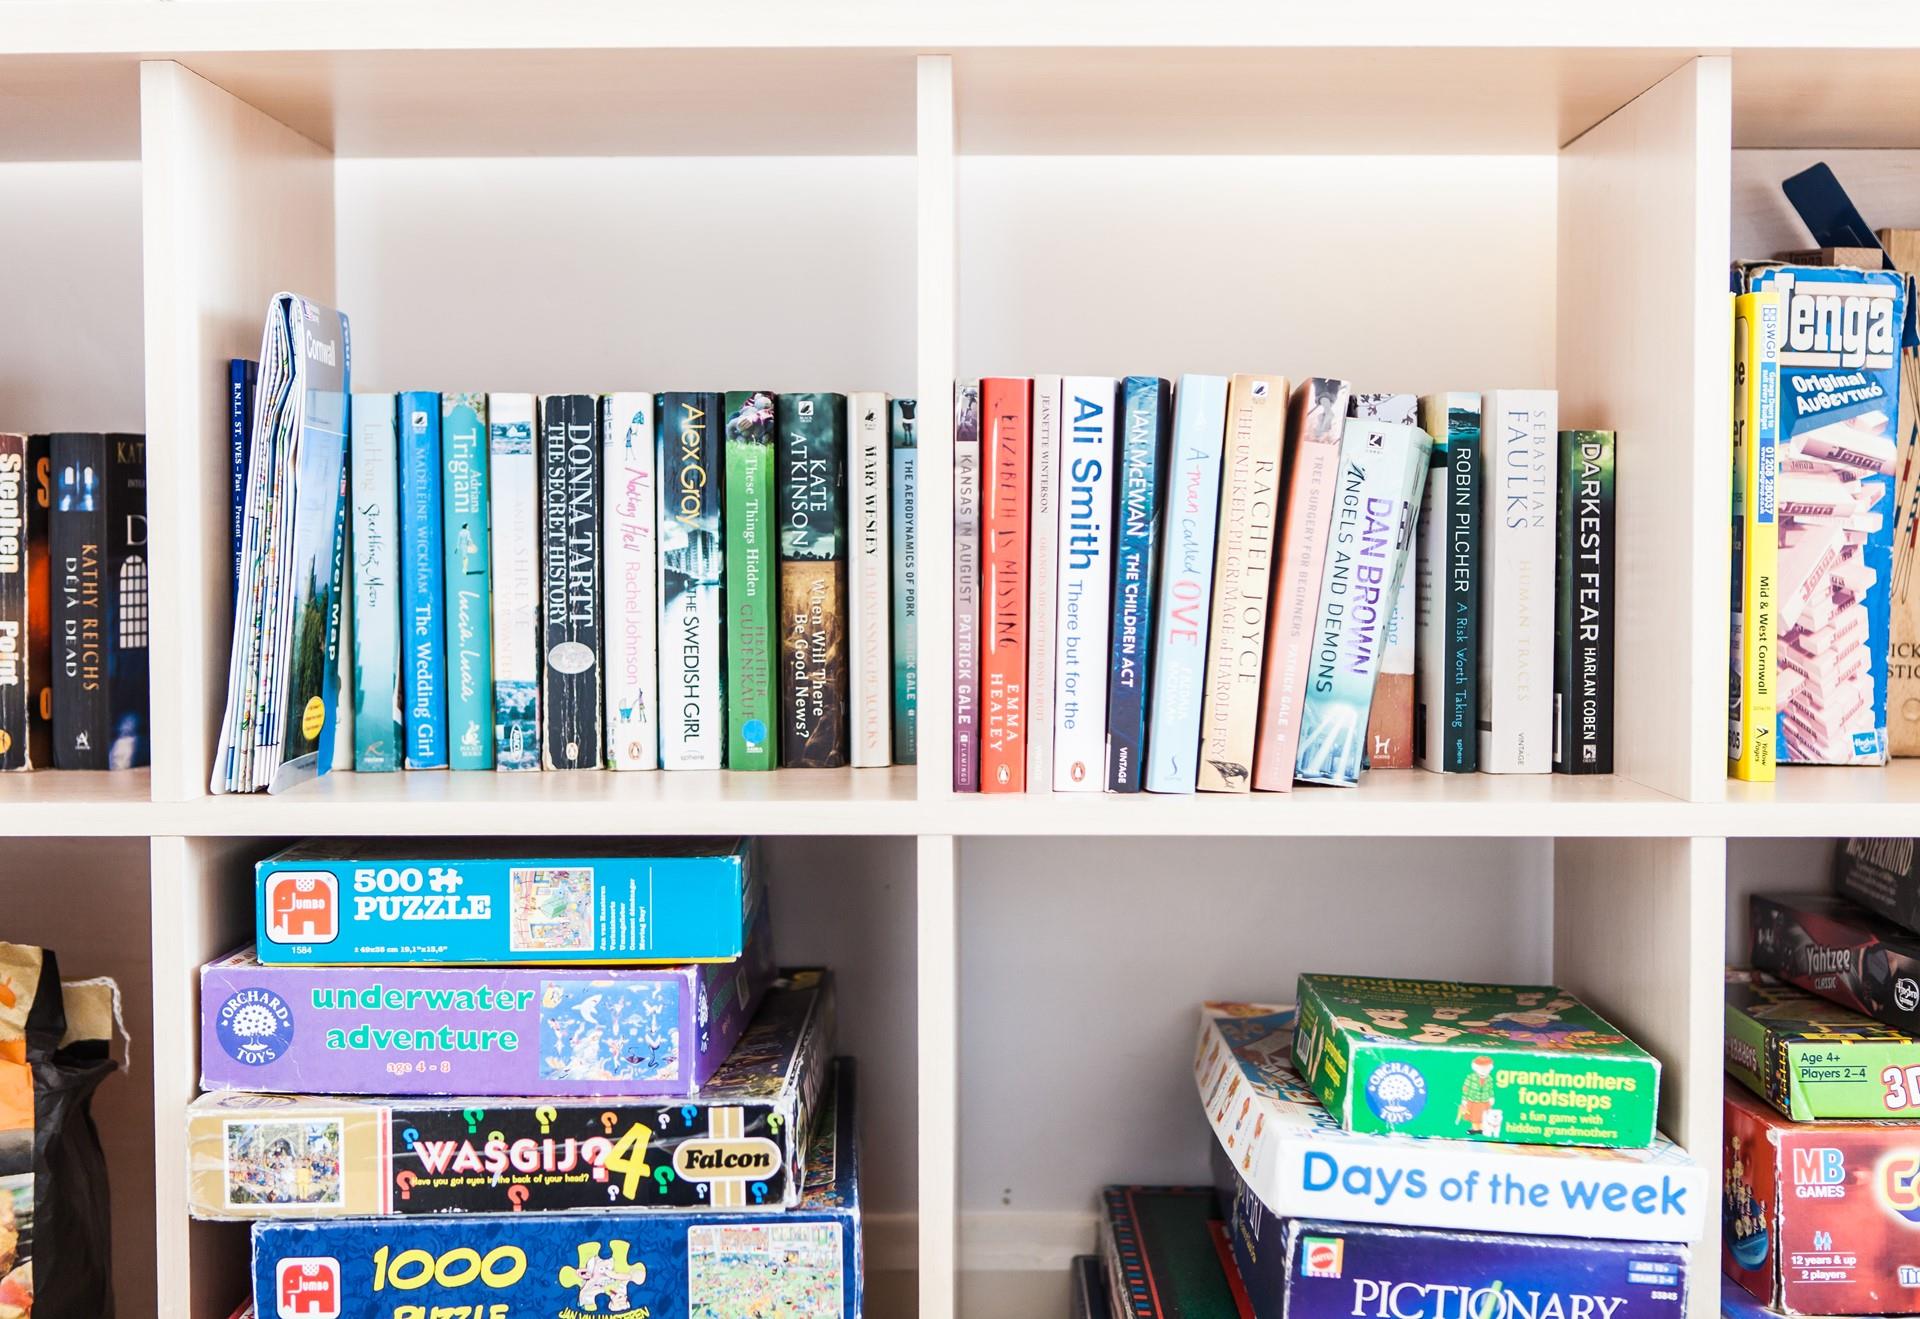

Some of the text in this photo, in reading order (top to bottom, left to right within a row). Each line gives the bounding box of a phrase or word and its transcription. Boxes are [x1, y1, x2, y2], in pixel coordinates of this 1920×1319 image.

[306, 330, 336, 367] Cornwall
[1766, 323, 1776, 359] SWGD
[1775, 272, 1894, 369] Jenga
[1792, 372, 1867, 394] Original
[1796, 382, 1884, 415] Αυθεντικό
[448, 428, 476, 514] Trigiani
[675, 402, 707, 529] Alex Gray
[810, 459, 827, 512] KATE
[864, 445, 878, 491] MARY
[1039, 394, 1050, 514] JEANETTE WINTERSON
[1069, 396, 1103, 570] Ali Smith
[1126, 410, 1148, 536] IAN McEWAN
[1186, 447, 1210, 462] A
[1506, 411, 1529, 529] FAULKS
[1532, 410, 1546, 528] SEBASTIAN
[1766, 446, 1775, 515] 01208 280037
[469, 468, 482, 513] Adriana
[616, 466, 650, 553] Notting Hell
[791, 432, 809, 547] ATKINSON
[1186, 464, 1201, 513] man
[1246, 460, 1274, 577] RACHEL
[1454, 448, 1471, 592] ROBIN PILCHER
[548, 422, 567, 627] THE SECRET HISTORY
[567, 422, 593, 627] DONNA TARTT
[743, 456, 760, 597] These Things Hidden
[865, 494, 878, 559] WESLEY
[904, 459, 916, 617] THE AERODYNAMICS OF PORK
[960, 454, 973, 604] KANSAS IN AUGUST
[998, 415, 1018, 649] ELIZABETH IS MISSING
[1182, 518, 1201, 575] called
[1291, 455, 1325, 638] TREE SURGERY FOR BEGINNERS
[1360, 497, 1393, 560] DAN
[1579, 443, 1601, 641] DARKEST FEAR
[329, 506, 346, 661] Travel Map
[412, 447, 435, 757] MADELEINE WICKHAM The Wedding Girl
[1316, 462, 1366, 693] ANGELS AND DEMONS
[1759, 576, 1770, 598] Mid
[1759, 600, 1769, 610] &
[81, 543, 99, 691] KATHY REICHS
[625, 562, 643, 685] Rachel Johnson
[1119, 553, 1140, 688] THE CHILDREN ACT
[1169, 580, 1202, 647] OVE
[1237, 590, 1263, 685] JOYCE
[1345, 564, 1384, 676] BROWN
[1758, 613, 1768, 642] West
[740, 603, 755, 719] GUDENKAUF
[755, 625, 768, 698] HEATHER
[795, 613, 811, 739] Be Good News?
[811, 580, 827, 718] When Will There
[957, 613, 973, 725] PATRICK GALE
[1064, 579, 1083, 730] There but for the
[1452, 602, 1468, 728] A Risk Worth Taking
[1583, 647, 1596, 696] HARLAN
[1757, 645, 1768, 695] Cornwall
[990, 673, 1003, 752] HEALEY
[1007, 684, 1020, 742] EMMA
[1278, 643, 1298, 727] PATRICK GALE
[1517, 733, 1525, 766] VINTAGE
[1583, 700, 1597, 740] COBEN
[960, 743, 968, 783] FLAMINGO
[1117, 746, 1128, 784] VINTAGE
[353, 867, 424, 893] 500
[353, 895, 492, 921] PUZZLE
[291, 946, 313, 955] 1584
[1806, 946, 1851, 976] Yahtzee
[221, 991, 289, 1020] ORCHARD
[311, 983, 535, 1012] underwater
[236, 1046, 276, 1064] TOYS
[325, 1024, 519, 1052] adventure
[1800, 1052, 1841, 1064] Age 4+
[1495, 1067, 1637, 1092] grandmothers
[1518, 1087, 1612, 1112] footsteps
[1505, 1122, 1618, 1140] hidden grandmothers
[1520, 1112, 1604, 1127] a fun game with
[411, 1176, 431, 1186] Have
[433, 1177, 449, 1188] you
[450, 1177, 465, 1187] got
[466, 1178, 485, 1187] eyes
[498, 1175, 511, 1184] the
[512, 1174, 532, 1184] back
[533, 1174, 543, 1184] of
[544, 1175, 563, 1186] your
[564, 1173, 590, 1183] head?
[684, 1149, 771, 1171] Falcon
[1303, 1151, 1687, 1216] Days of the week
[1793, 1148, 1846, 1185] MB
[1795, 1185, 1846, 1199] GAMES
[372, 1245, 528, 1292] 1000
[1791, 1255, 1857, 1268] 12 years & up
[1801, 1270, 1847, 1281] 2 players
[1351, 1279, 1625, 1319] PICTIONARY
